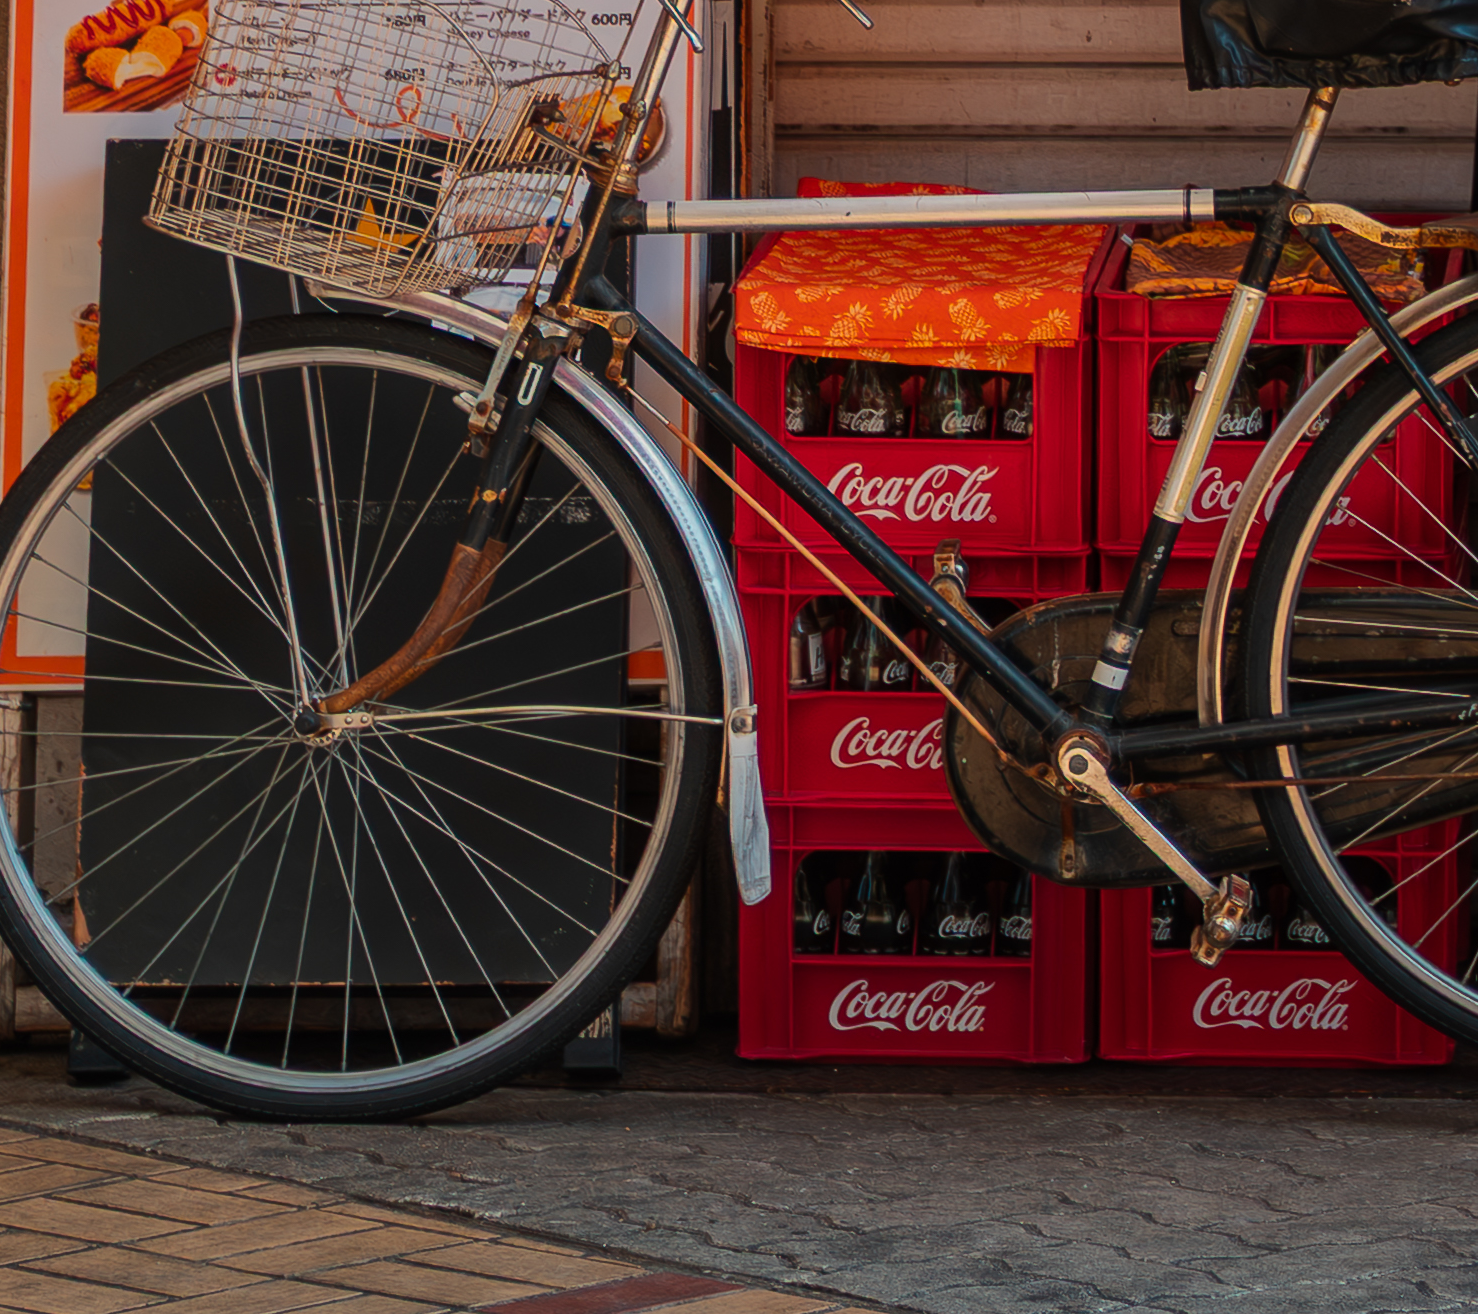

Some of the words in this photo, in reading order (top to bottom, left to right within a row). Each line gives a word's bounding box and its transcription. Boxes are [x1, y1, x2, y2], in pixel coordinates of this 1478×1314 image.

[591, 13, 632, 26] 600円
[826, 462, 1000, 522] Coca-Cola
[828, 978, 996, 1033] Coca-Cola
[1192, 977, 1359, 1031] Coca-Cola
